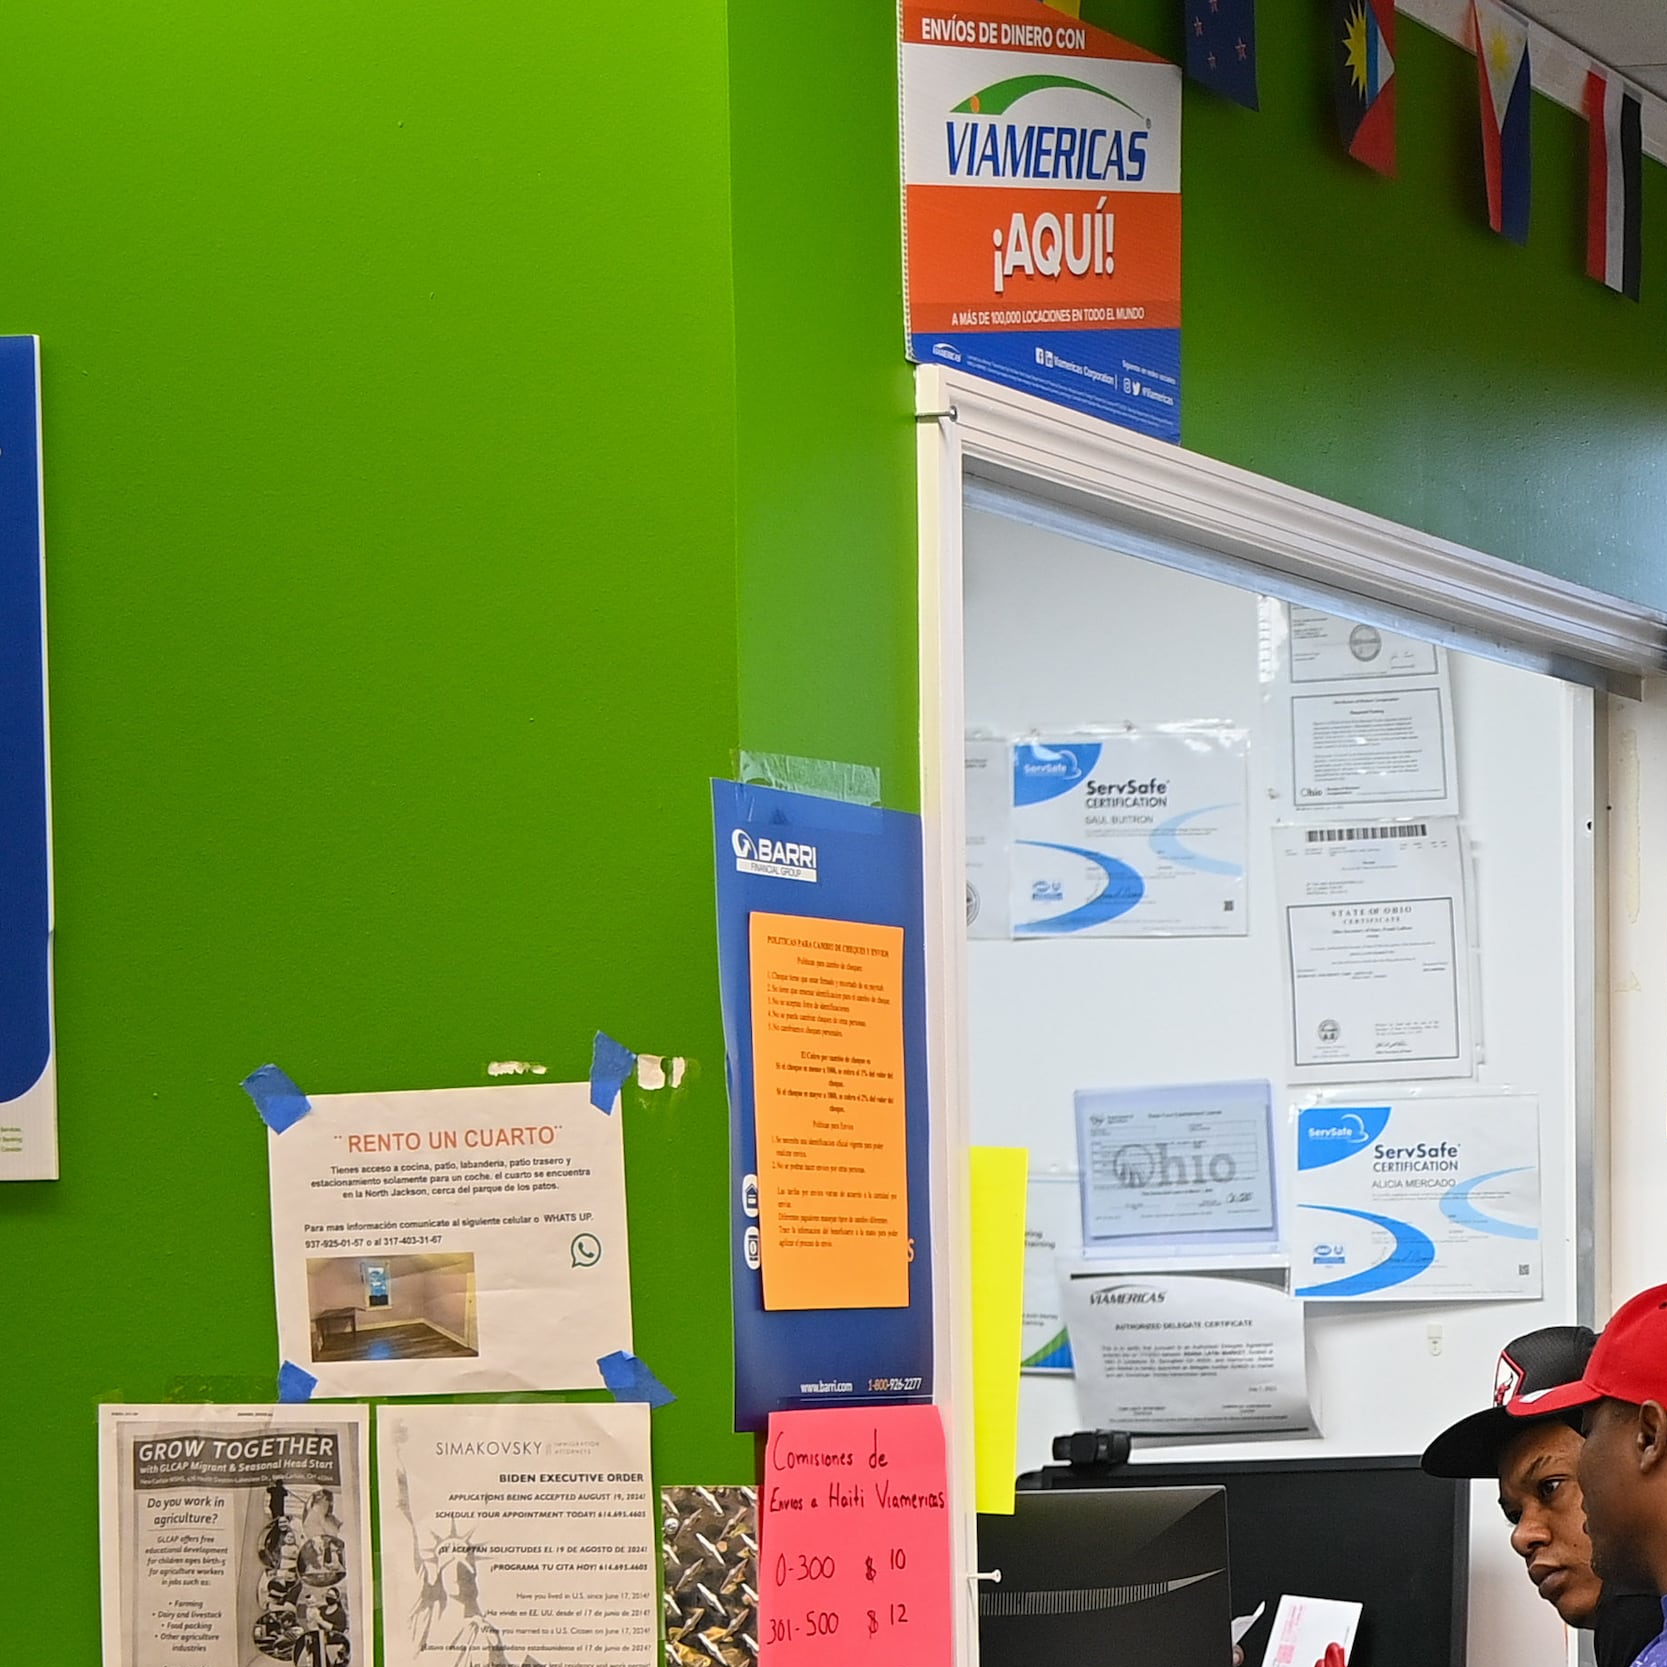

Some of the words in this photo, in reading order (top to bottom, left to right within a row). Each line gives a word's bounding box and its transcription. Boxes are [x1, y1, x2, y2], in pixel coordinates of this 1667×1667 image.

[922, 15, 976, 43] ENVÍOS
[979, 22, 997, 45] DE
[1001, 23, 1053, 48] DINERO
[1056, 27, 1085, 50] CON
[946, 121, 1148, 181] VIAMERICAS
[993, 197, 1115, 292] ¡AQUÍ!
[952, 314, 958, 325] A
[960, 309, 978, 325] MÁS
[979, 313, 989, 324] DE
[991, 312, 1021, 325] 100,000
[1023, 309, 1070, 323] LOCACIONES
[1072, 309, 1083, 321] EN
[1084, 308, 1105, 321] TODO
[1106, 308, 1114, 320] EL
[1116, 307, 1144, 320] MUNDO
[1024, 761, 1067, 776] ServSafe
[1086, 779, 1168, 796] ServSafe
[1086, 796, 1167, 808] CERTIFICATION
[757, 838, 817, 868] BARRI
[779, 865, 802, 878] GROUP
[1308, 1127, 1352, 1137] ServSafe
[349, 1132, 420, 1153] RENTO
[428, 1130, 457, 1150] UN
[1374, 1143, 1458, 1159] ServSafe
[1373, 1160, 1458, 1172] CERTIFICATION
[343, 1190, 353, 1198] en
[355, 1190, 363, 1198] la
[365, 1189, 389, 1198] North
[391, 1188, 429, 1197] Jackson,
[432, 1187, 456, 1195] cerca
[458, 1185, 470, 1193] del
[473, 1185, 502, 1195] parque
[504, 1184, 515, 1192] de
[517, 1183, 530, 1191] los
[532, 1183, 560, 1192] patos.
[1372, 1179, 1403, 1188] ALICIA
[1405, 1178, 1456, 1188] MERCADO
[374, 1238, 381, 1246] al
[1089, 1291, 1166, 1305] VIAMERICAS
[800, 1379, 853, 1394] www.barri.com
[867, 1377, 922, 1392] 1-800-926-2277
[139, 1441, 203, 1462] GROW
[213, 1437, 334, 1458] TOGETHER
[436, 1441, 542, 1456] SIMAKOVSKY
[773, 1431, 853, 1471] Comisiones
[868, 1429, 888, 1468] de
[499, 1473, 536, 1483] BIDEN
[540, 1473, 603, 1483] EXECUTIVE
[607, 1473, 644, 1483] ORDER
[811, 1499, 818, 1510] a
[829, 1483, 864, 1510] Haiti
[875, 1480, 945, 1510] Viamericas
[148, 1497, 161, 1508] Do
[164, 1498, 181, 1511] you
[184, 1497, 208, 1508] work
[213, 1497, 224, 1508] in
[154, 1513, 218, 1526] agriculture?
[775, 1553, 835, 1586] 0-300
[889, 1548, 906, 1570] 10
[766, 1610, 839, 1645] 301-500
[889, 1604, 909, 1624] 12
